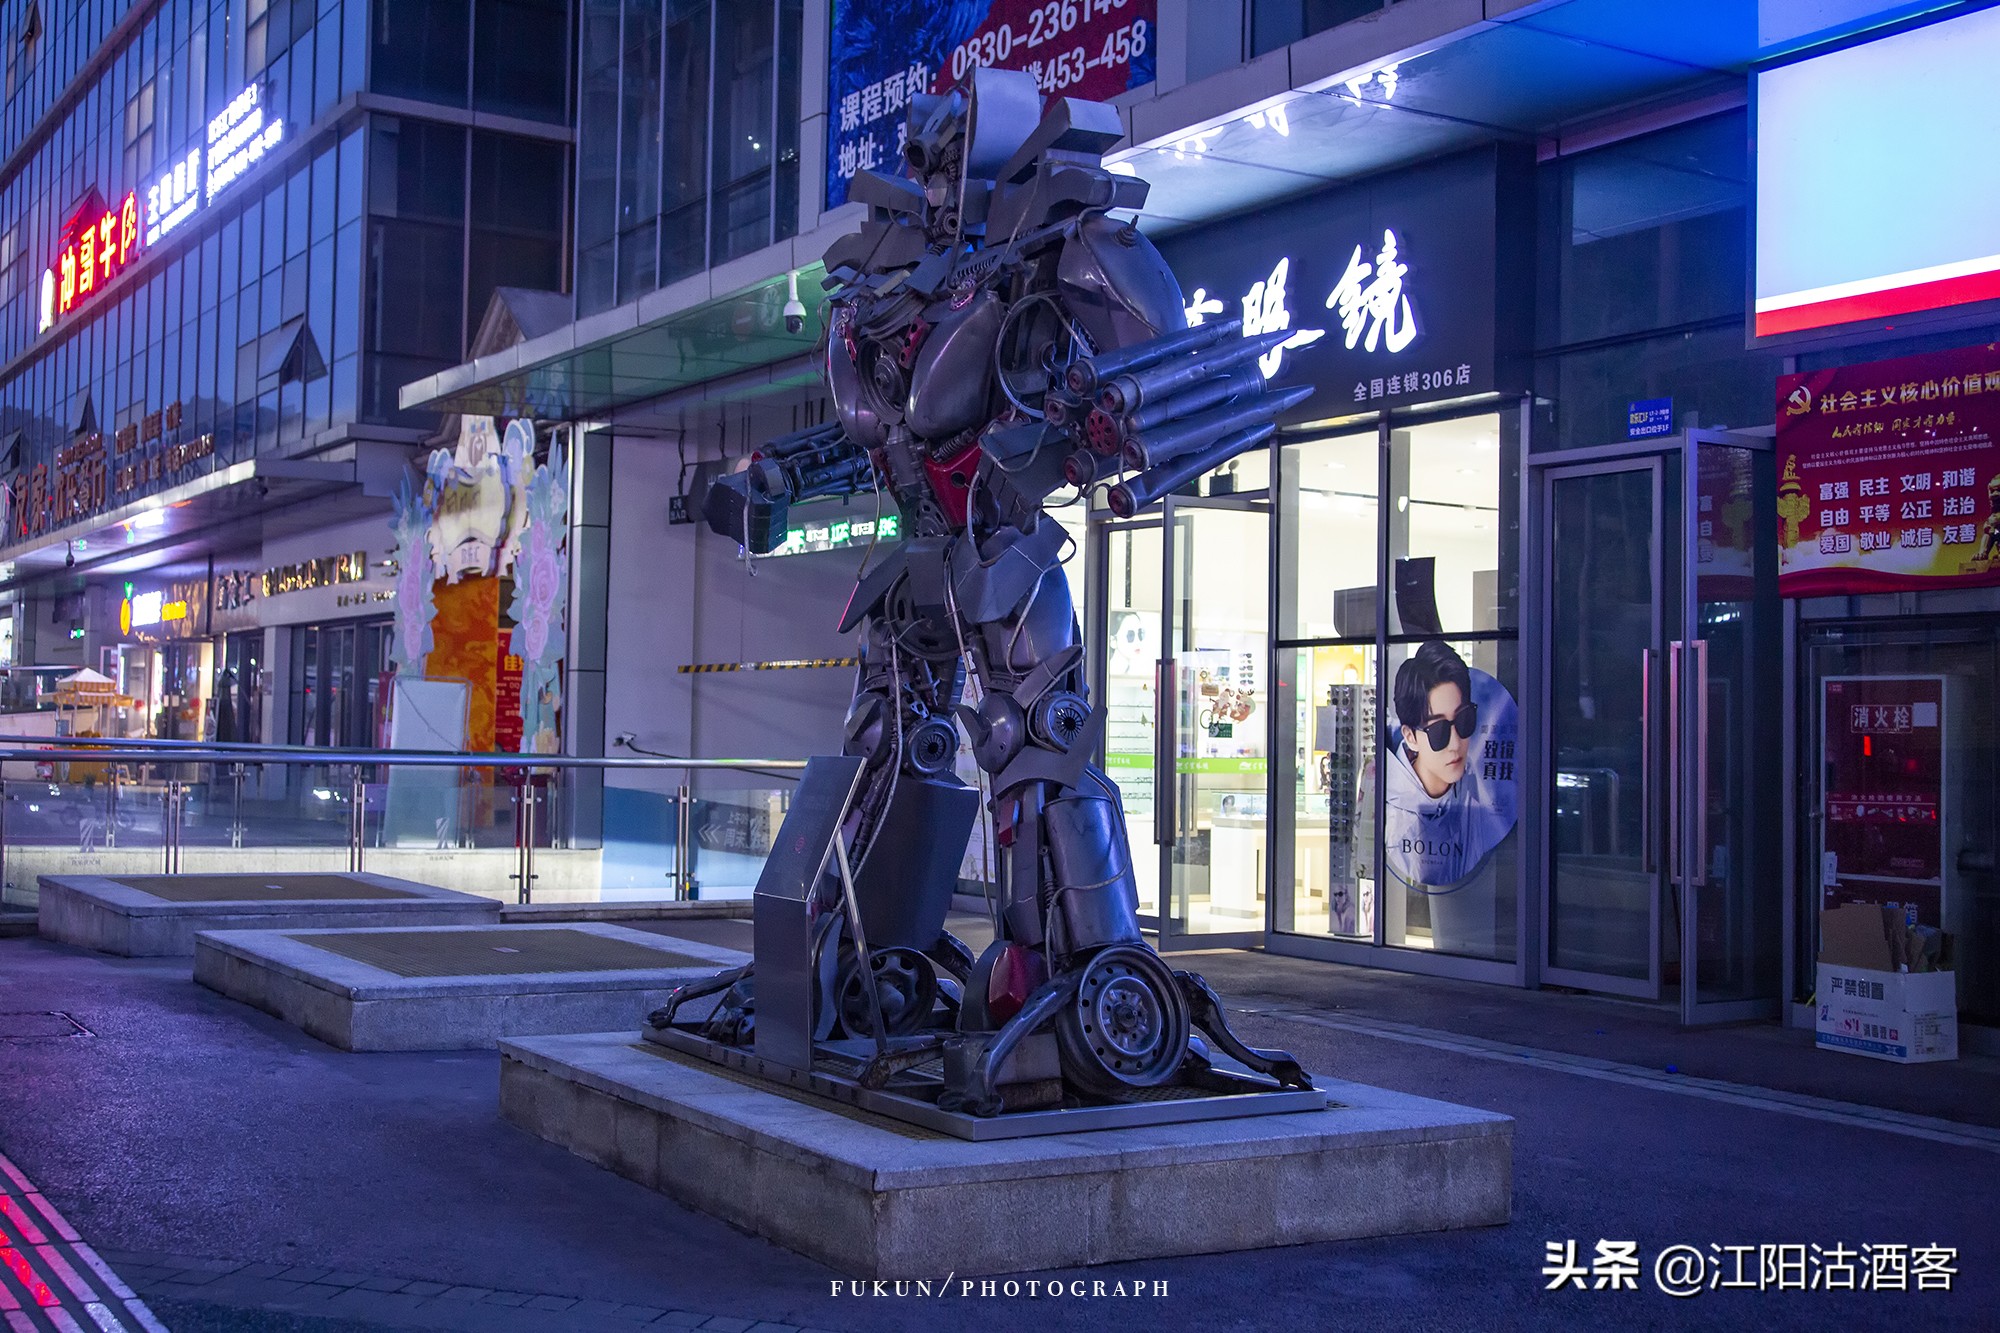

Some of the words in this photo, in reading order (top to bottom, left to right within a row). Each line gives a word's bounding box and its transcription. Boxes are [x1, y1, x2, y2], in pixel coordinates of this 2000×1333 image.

[951, 0, 1128, 80] 0830-2361
[1353, 363, 1471, 403] 全国连锁306店
[1819, 481, 1850, 501] 富强
[1859, 477, 1890, 497] 民主
[1900, 472, 1931, 493] 文明
[1942, 467, 1976, 490] 和谐
[1819, 507, 1850, 527] 自由
[1859, 504, 1891, 523] 平等
[1900, 500, 1932, 520] 公正
[1942, 496, 1976, 517] 法治
[1819, 534, 1850, 554] 爱国
[1859, 531, 1891, 550] 敬业
[1900, 526, 1933, 547] 诚信
[1942, 523, 1977, 544] 友善
[1853, 706, 1910, 729] 消火栓
[1402, 838, 1464, 857] BOLON
[1831, 976, 1884, 1001] 严禁倒置
